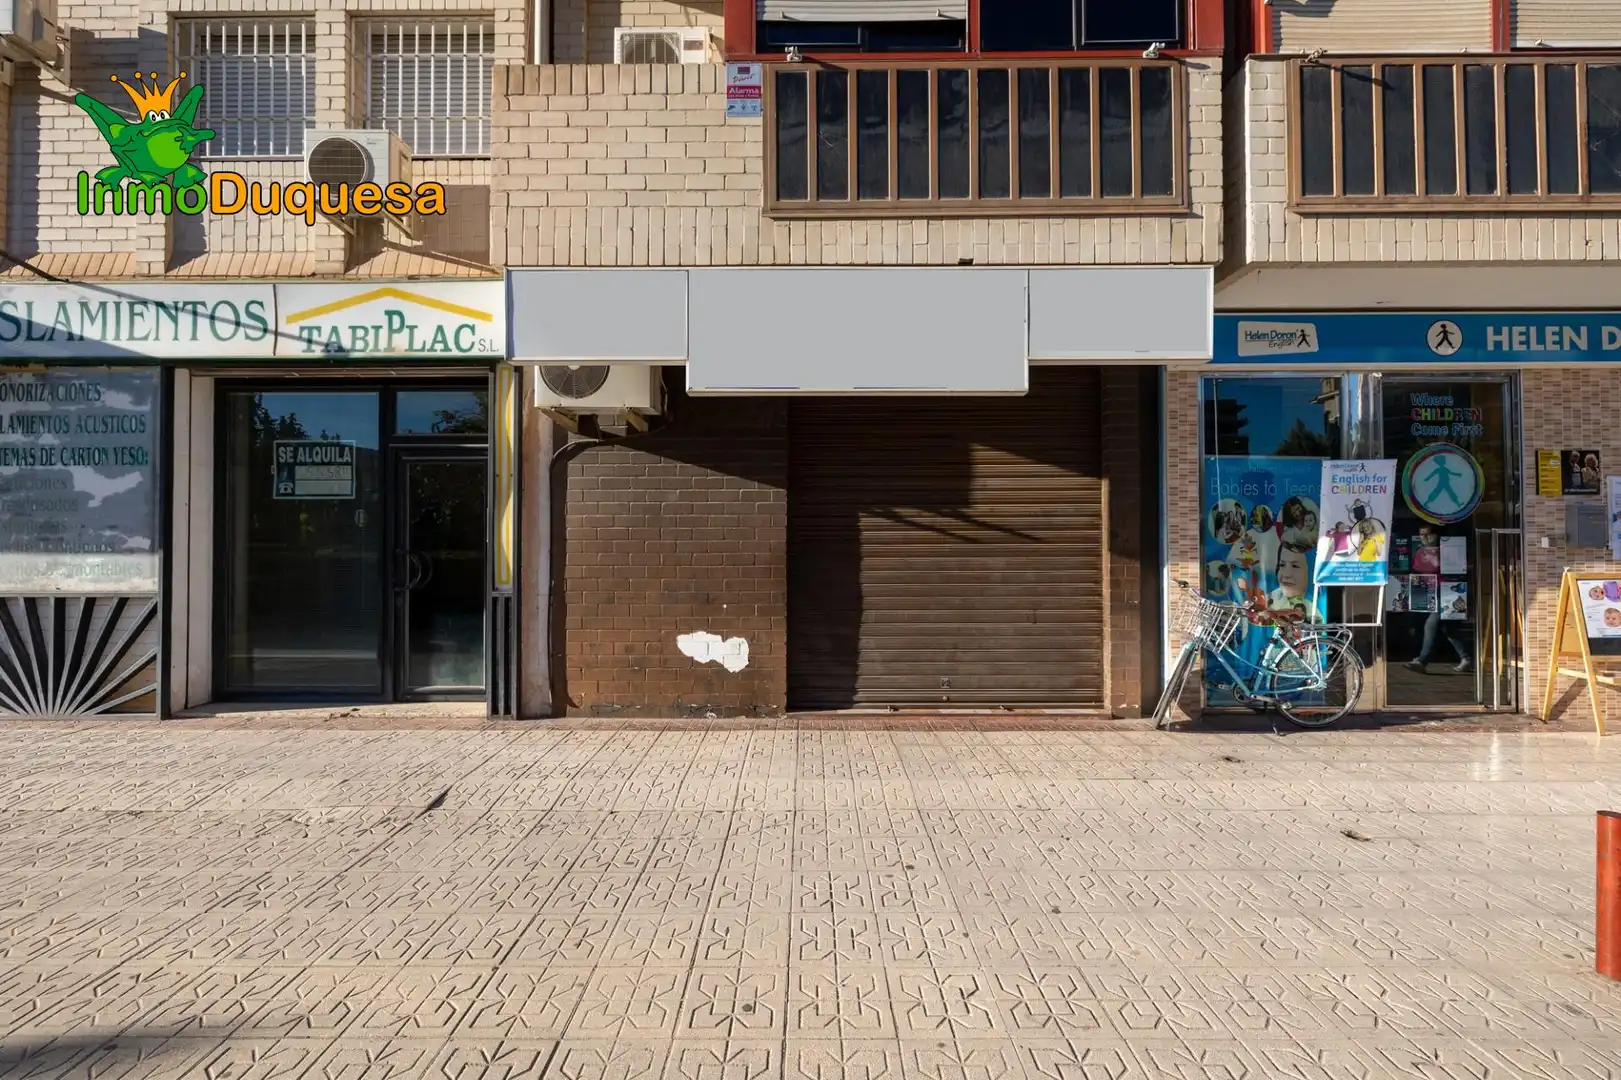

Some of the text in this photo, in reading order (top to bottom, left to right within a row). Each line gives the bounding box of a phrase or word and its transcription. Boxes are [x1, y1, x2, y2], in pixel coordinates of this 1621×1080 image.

[0, 300, 269, 342] SLAMIENTOS
[1486, 325, 1621, 351] HELEN D
[1410, 392, 1454, 406] Where
[1411, 407, 1483, 422] CHILDREN
[1411, 422, 1484, 436] Come First
[40, 447, 56, 466] DE
[60, 447, 109, 467] CARTON
[278, 446, 352, 464] SE ALQUILA
[1210, 478, 1259, 495] Babies
[1264, 480, 1277, 495] to
[1331, 473, 1388, 487] English for
[1331, 485, 1387, 495] CHILDREN
